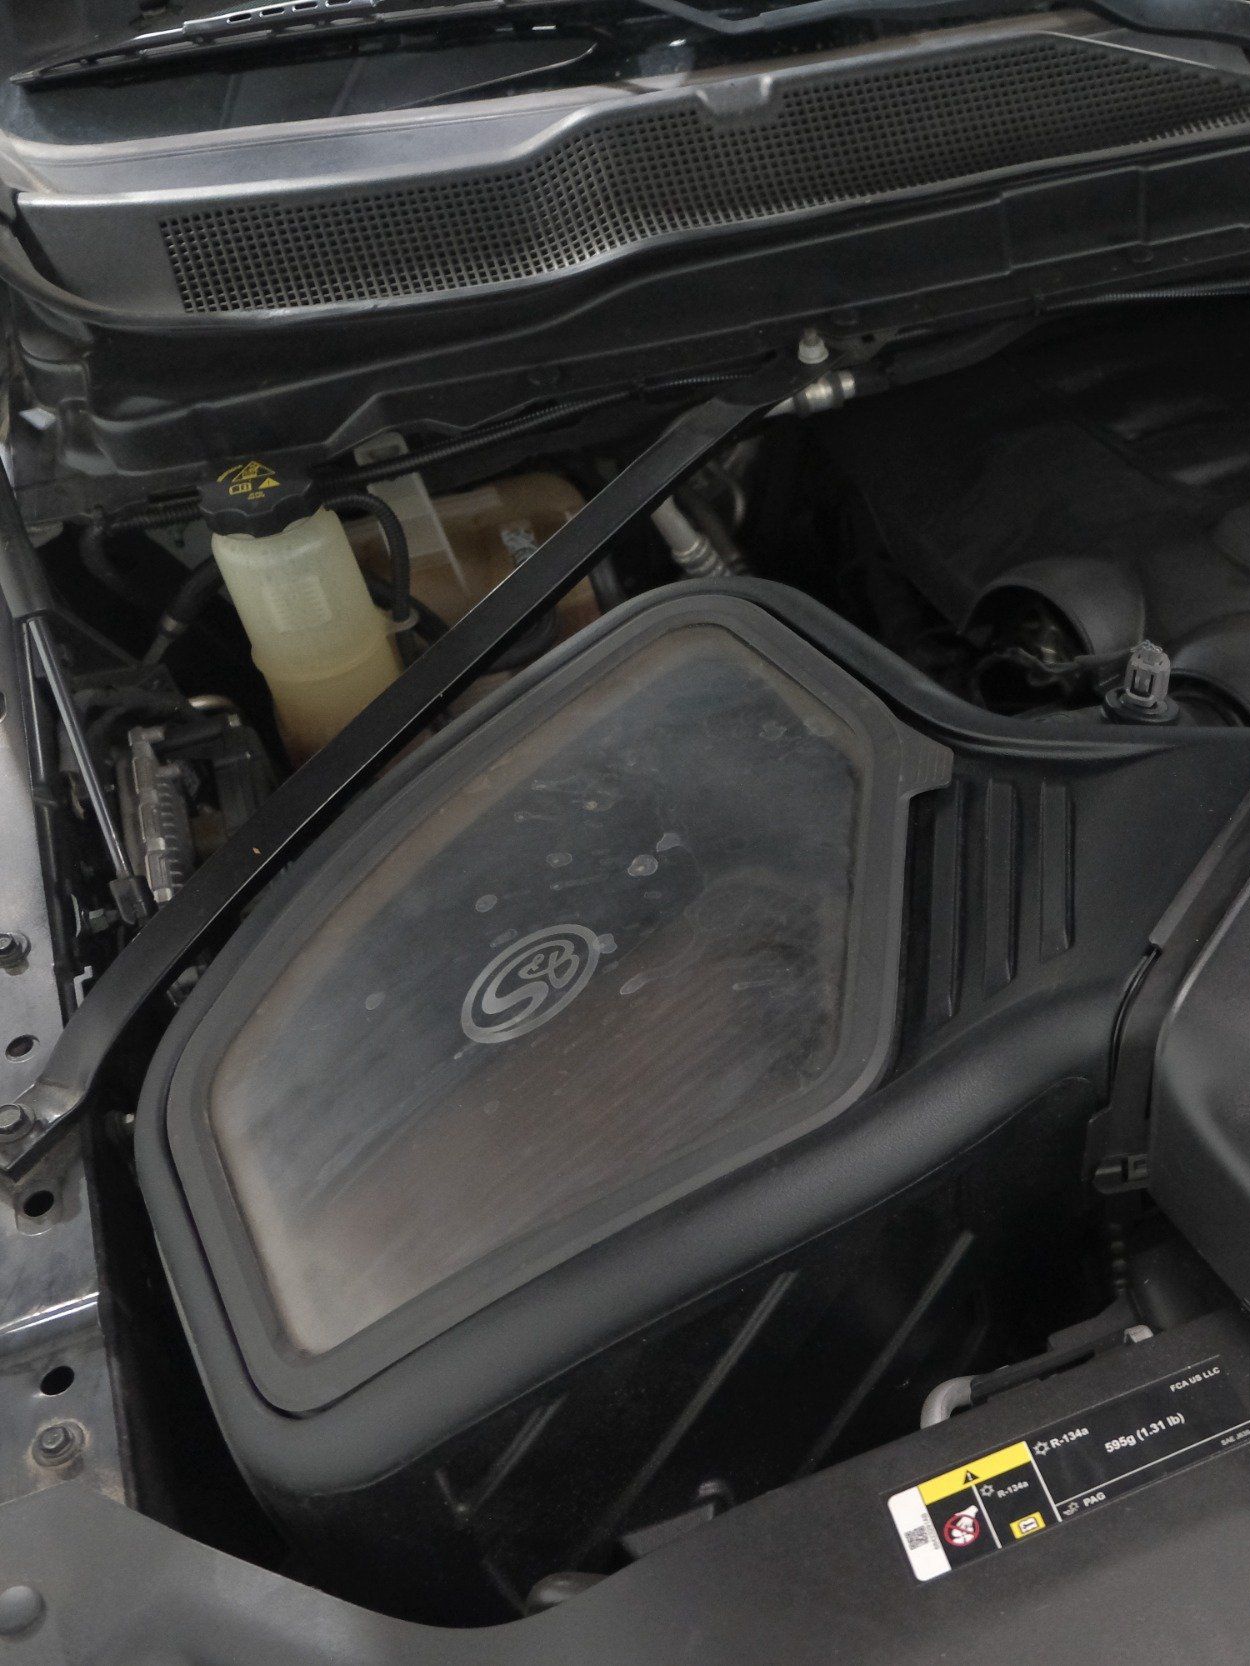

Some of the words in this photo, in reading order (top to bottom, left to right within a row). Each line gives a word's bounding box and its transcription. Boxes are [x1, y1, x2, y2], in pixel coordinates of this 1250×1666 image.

[481, 939, 580, 1031] S&B
[1169, 1380, 1190, 1393] FCA
[1188, 1374, 1203, 1385] US
[1202, 1366, 1221, 1380] LLC
[1049, 1426, 1090, 1449] R-134a
[1104, 1434, 1138, 1454] 595g
[1136, 1419, 1166, 1442] (1.31
[1166, 1412, 1186, 1429] lb)
[996, 1480, 1030, 1499] R-134a
[1082, 1491, 1107, 1508] PAG
